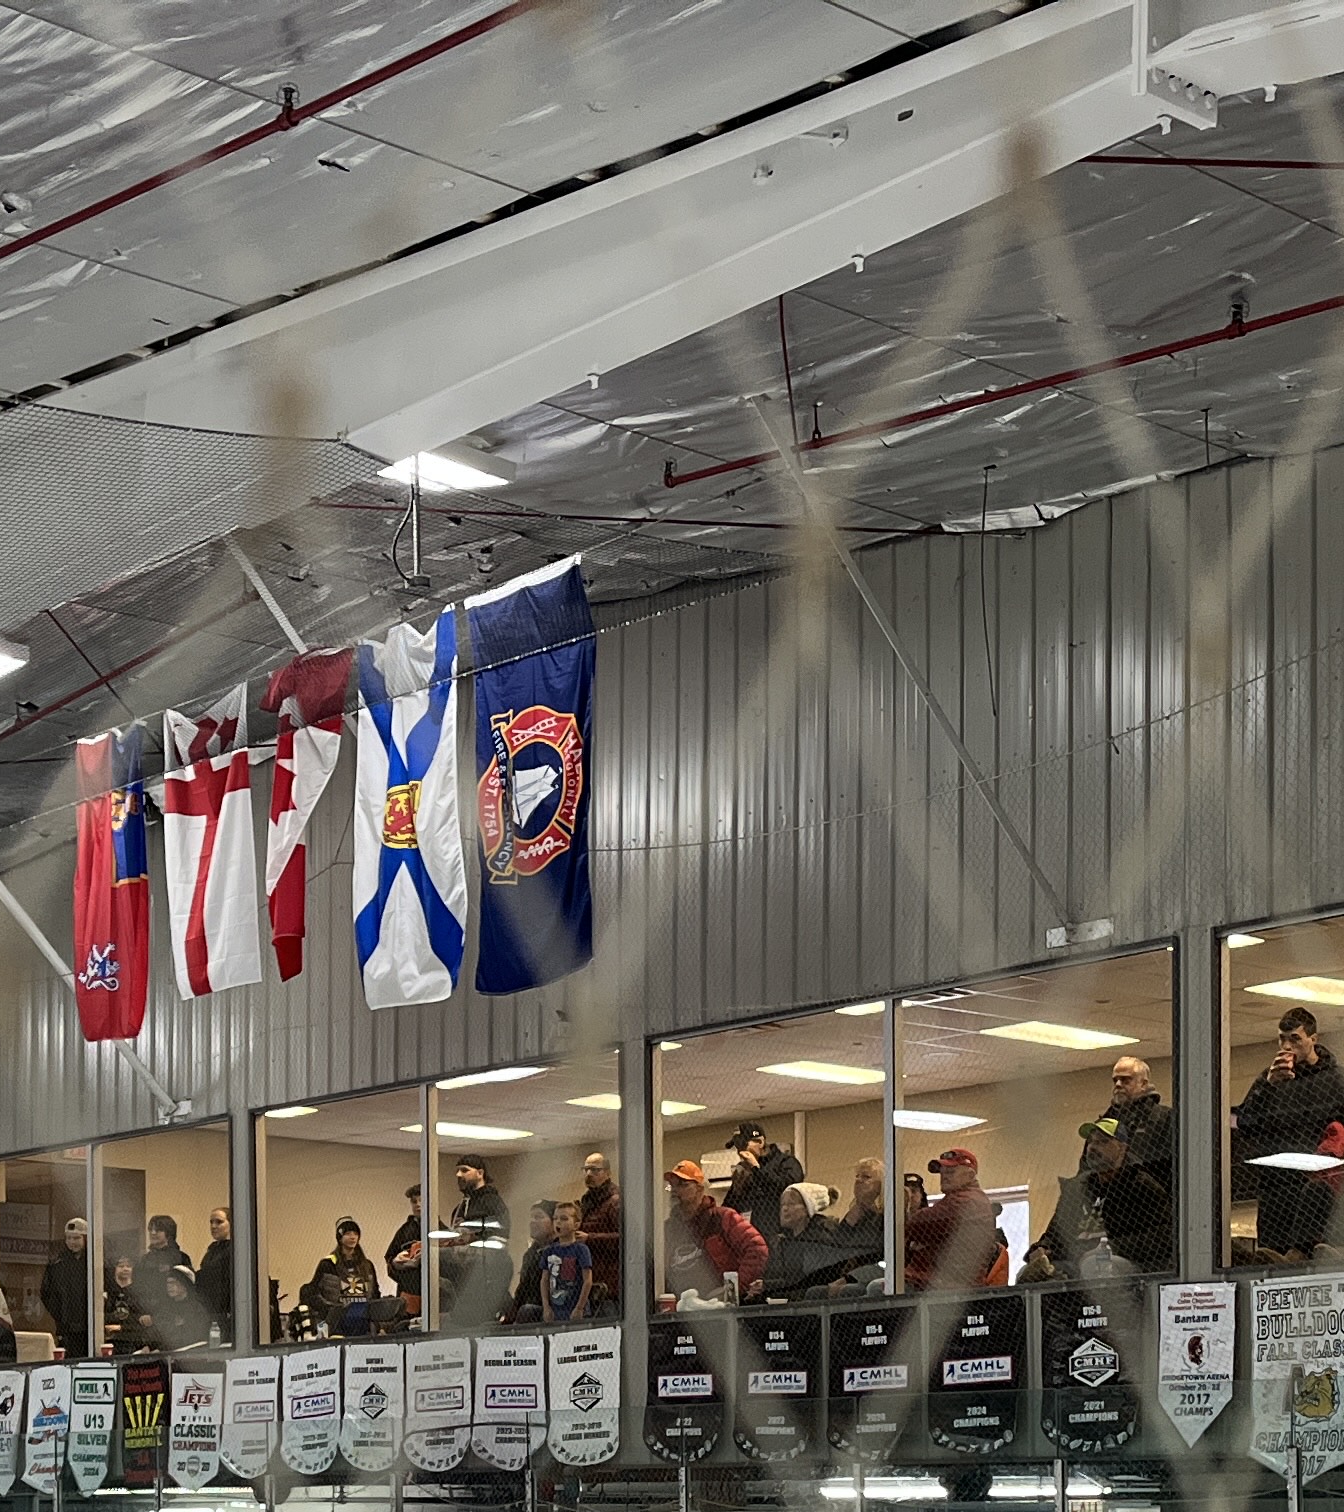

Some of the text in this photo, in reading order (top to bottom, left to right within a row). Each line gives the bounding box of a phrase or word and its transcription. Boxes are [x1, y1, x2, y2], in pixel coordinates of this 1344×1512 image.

[491, 730, 507, 761] FIRE
[484, 805, 499, 837] 1754
[1256, 1284, 1332, 1311] PEEWEE
[1078, 1317, 1107, 1328] PLAYOFFS
[1175, 1313, 1218, 1323] Bantam B
[962, 1326, 990, 1337] PLAYOFFS
[861, 1335, 887, 1346] PLAYOFFS
[578, 1352, 614, 1362] CHAMPIONS
[1256, 1341, 1298, 1362] FALL
[960, 1360, 1005, 1372] CMHL
[1074, 1356, 1114, 1368] CMHF
[763, 1374, 801, 1384] CMHL
[859, 1368, 902, 1380] CMHL
[671, 1377, 707, 1386] CMHL
[179, 1388, 212, 1404] JETS
[428, 1392, 458, 1400] CMHL
[500, 1389, 532, 1397] CMHL
[573, 1387, 600, 1396] CMHF
[304, 1398, 330, 1407] CMHL
[1180, 1394, 1210, 1404] 2017
[245, 1405, 270, 1413] CMHL
[966, 1407, 987, 1416] 2024
[1083, 1401, 1105, 1411] 2021
[1174, 1407, 1213, 1416] CHAMPS
[84, 1414, 104, 1429] U13
[676, 1417, 692, 1426] 222
[953, 1416, 1000, 1428] CHAMPIONS
[1069, 1412, 1119, 1423] CHAMPIONS
[174, 1424, 216, 1438] CLASSIC
[77, 1434, 107, 1446] SILVER
[173, 1441, 216, 1451] CHAMPIONS
